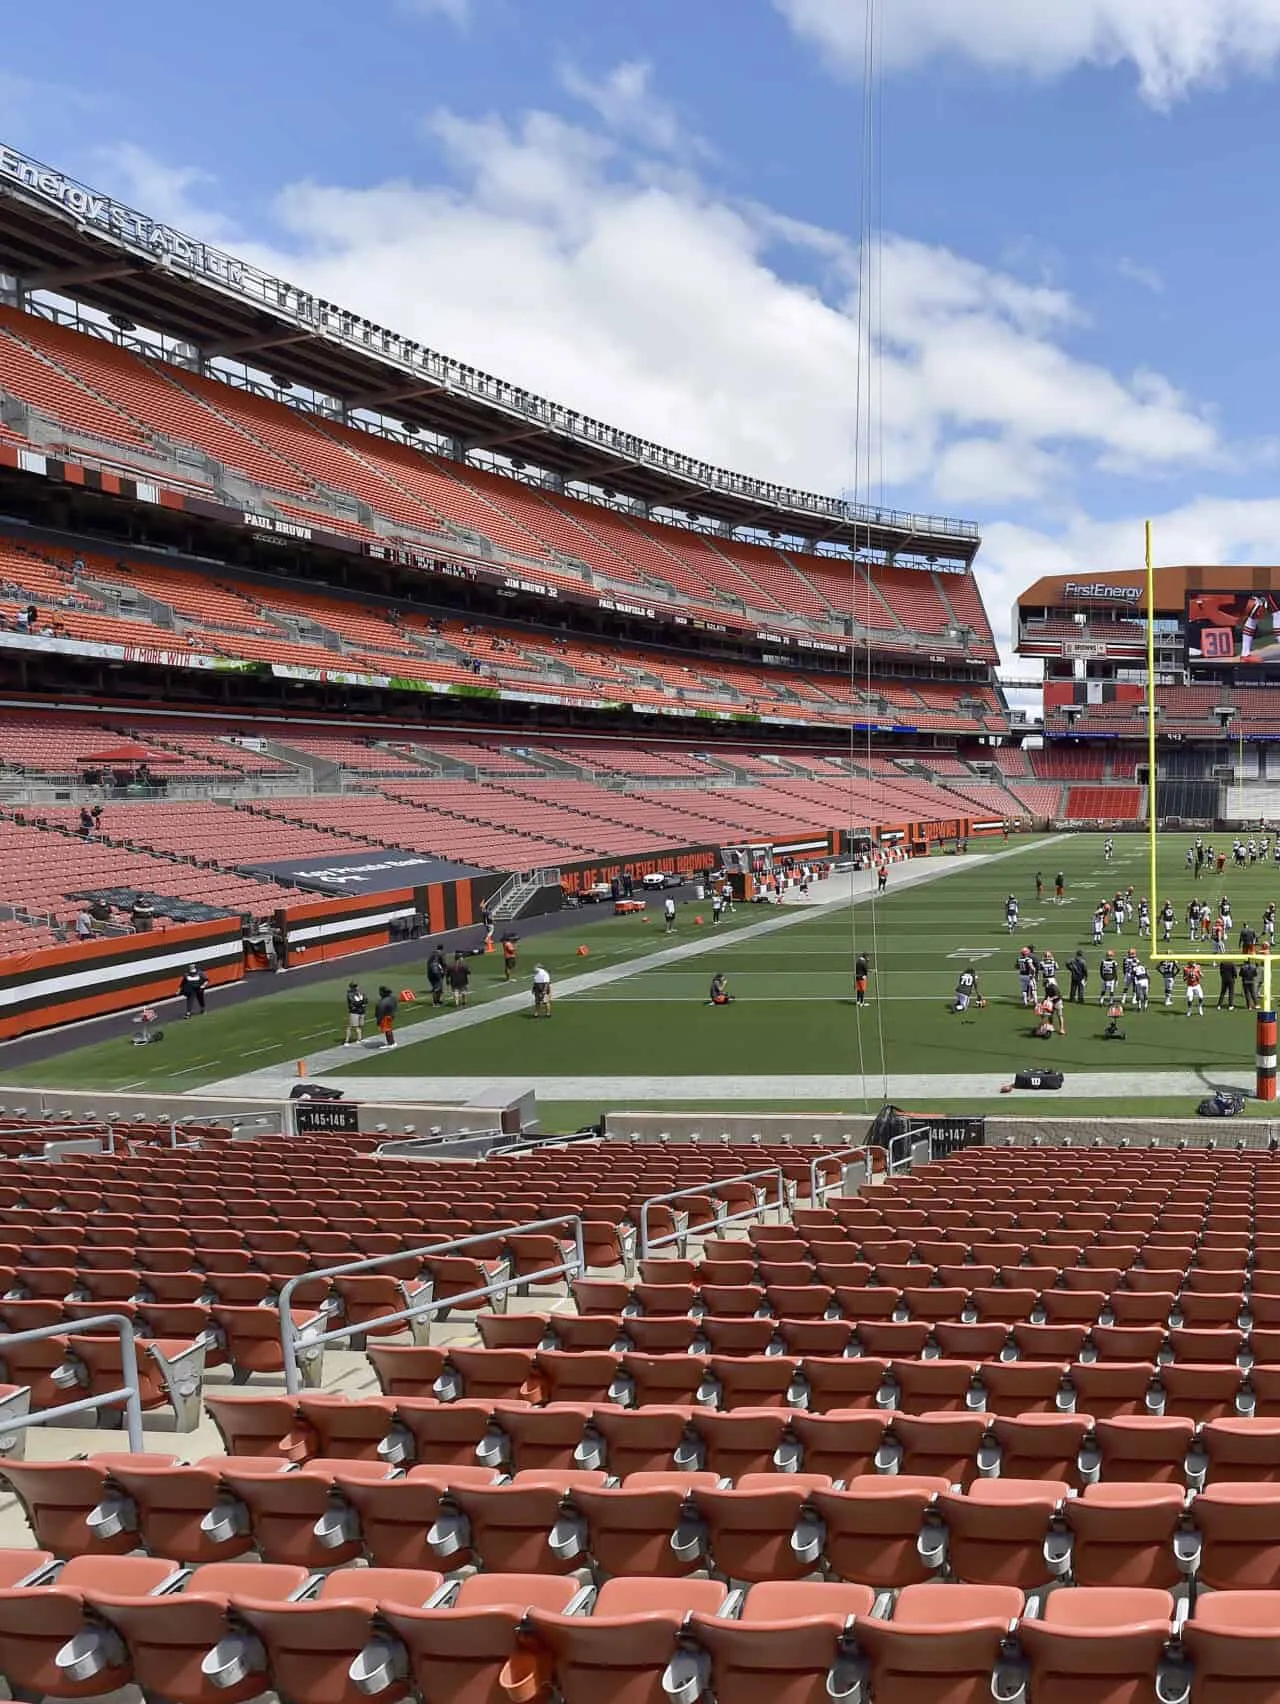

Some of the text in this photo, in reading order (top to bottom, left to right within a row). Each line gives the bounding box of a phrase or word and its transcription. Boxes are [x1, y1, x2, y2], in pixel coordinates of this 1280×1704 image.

[244, 513, 312, 540] PAUL BROWN
[505, 578, 558, 598] JIM BROWN 32
[1065, 582, 1143, 602] FirstEnergy
[1204, 632, 1231, 656] 30
[624, 855, 675, 882] CLEVELAND
[960, 973, 973, 986] 70
